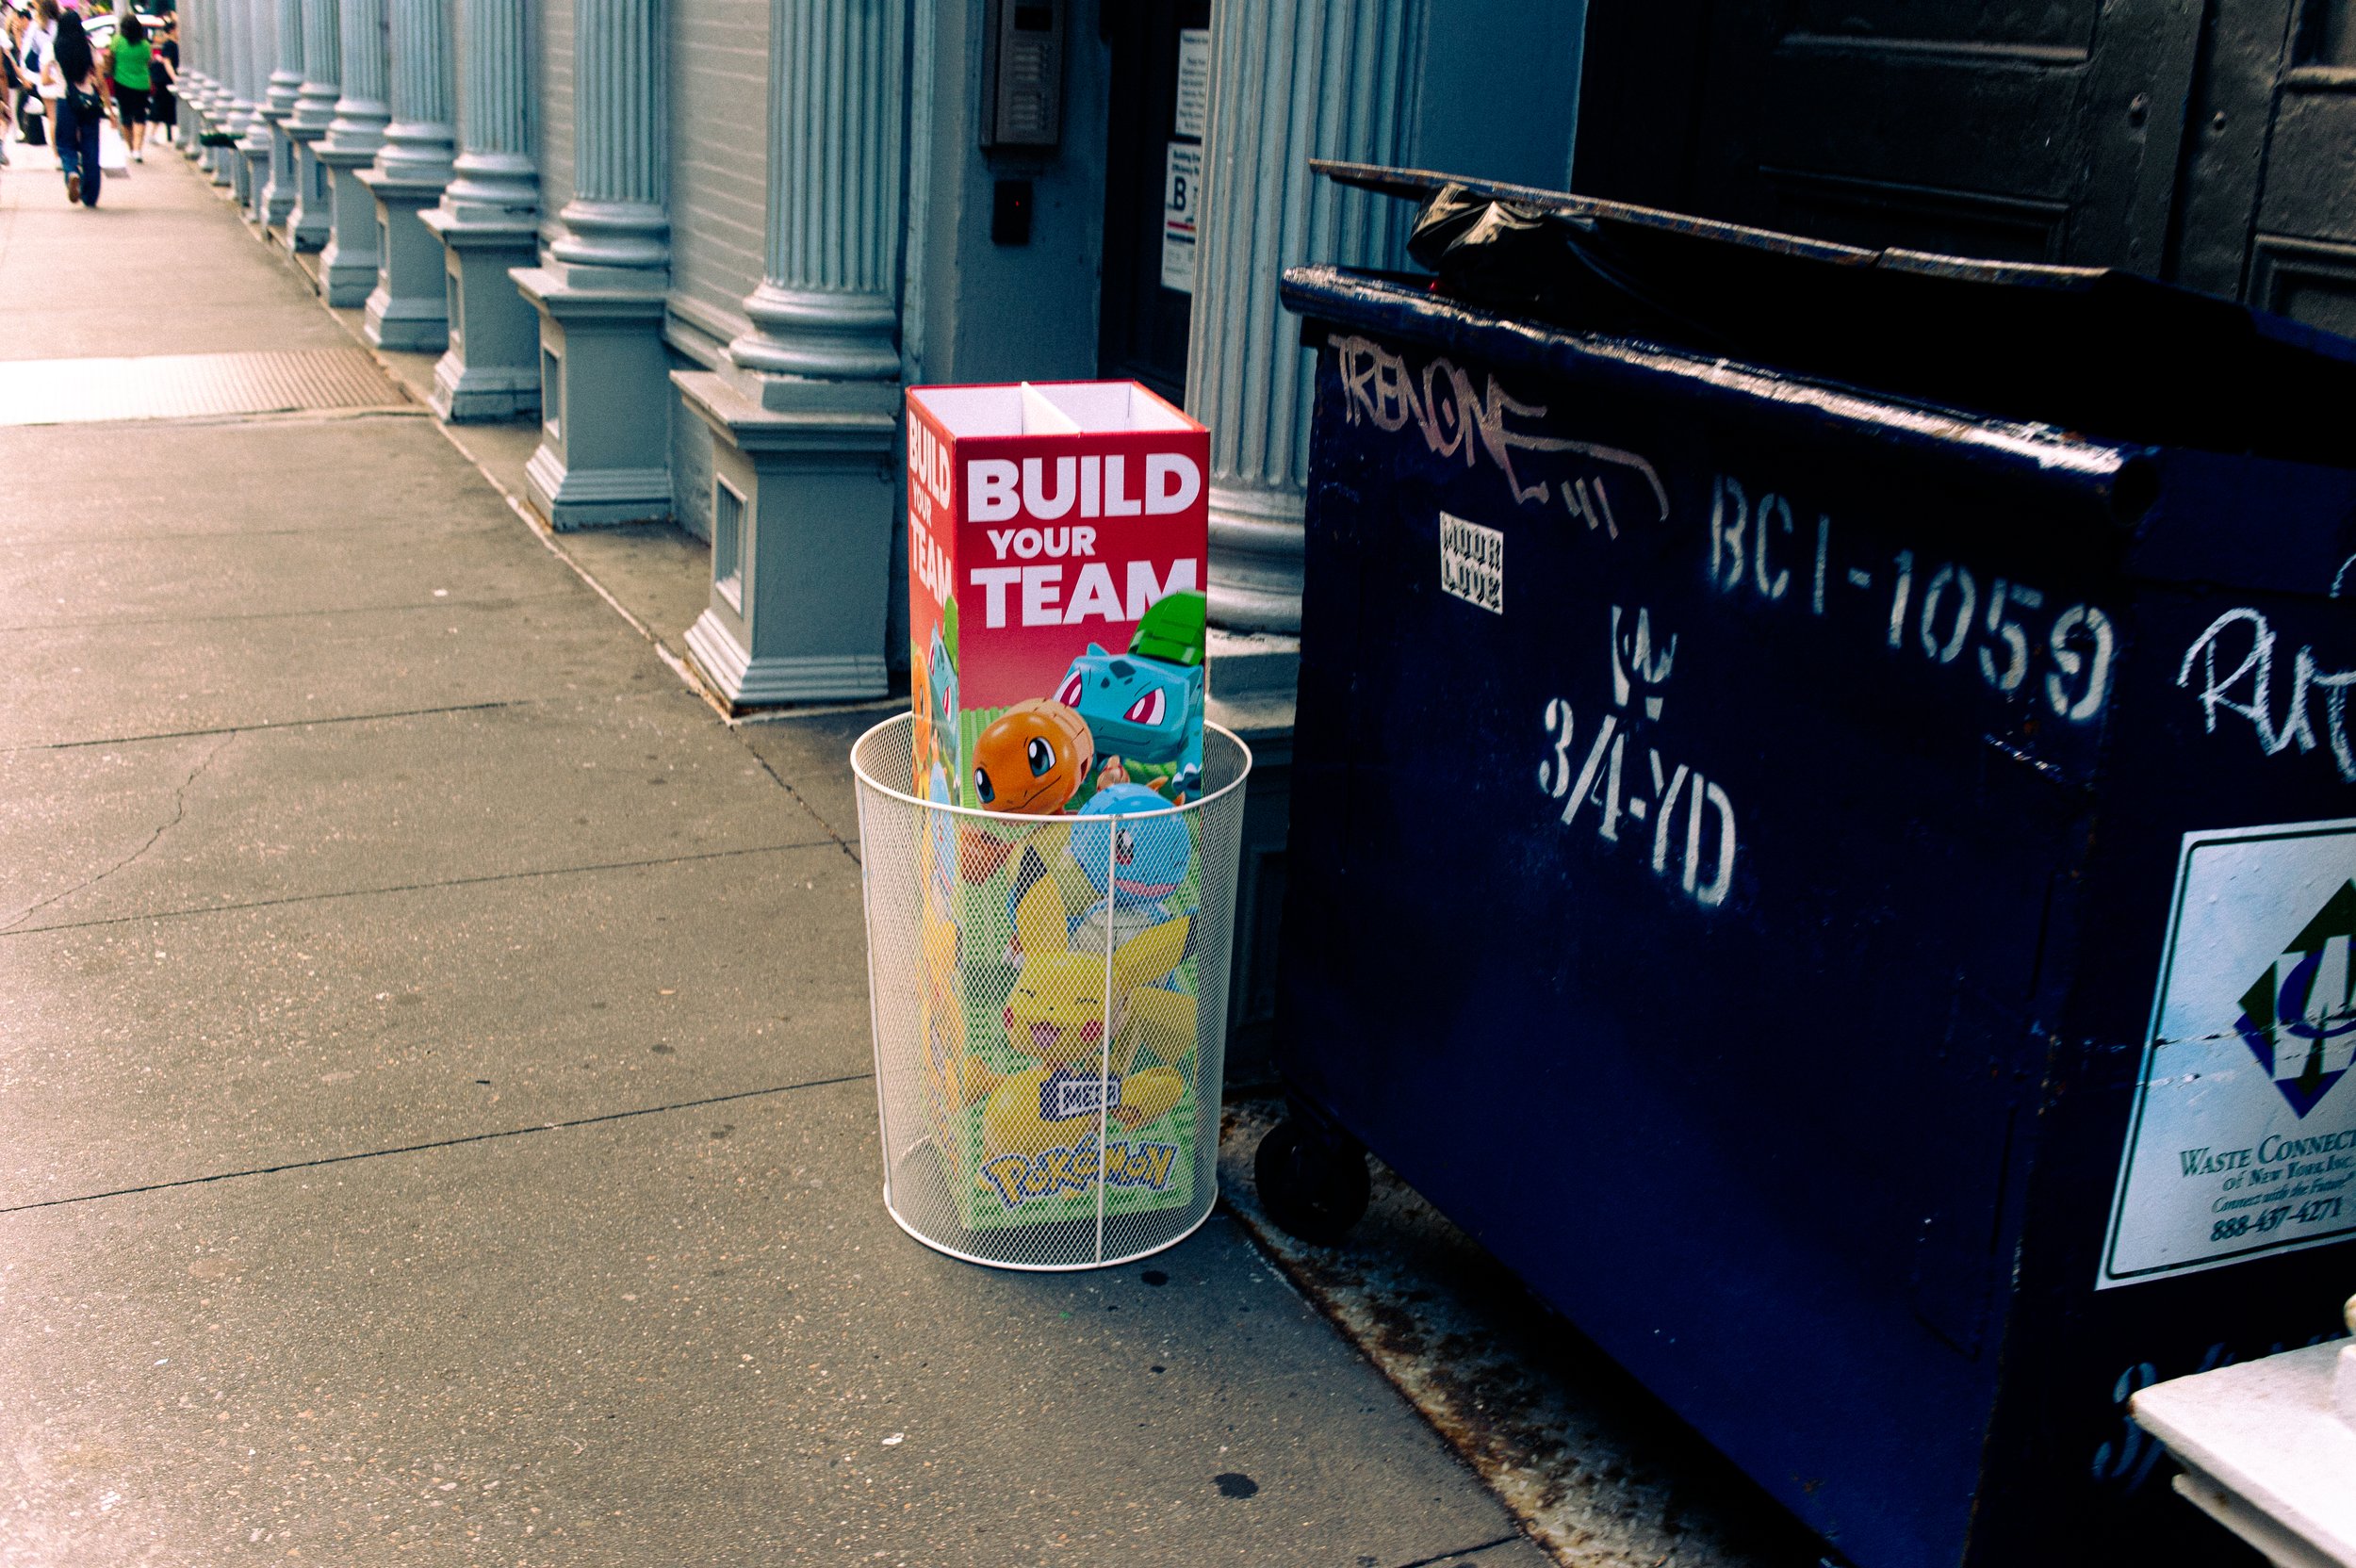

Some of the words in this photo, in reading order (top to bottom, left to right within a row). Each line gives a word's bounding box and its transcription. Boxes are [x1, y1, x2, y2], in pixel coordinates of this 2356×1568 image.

[908, 408, 951, 511] BUILD
[912, 477, 932, 528] YOUR
[967, 452, 1201, 523] BUILD
[909, 510, 953, 612] TEAM
[987, 526, 1097, 560] YOUR
[970, 558, 1198, 629] TEAM
[2179, 1147, 2253, 1178] WASTE
[2222, 1169, 2246, 1191] of
[2210, 1196, 2344, 1242] 888-437-4271
